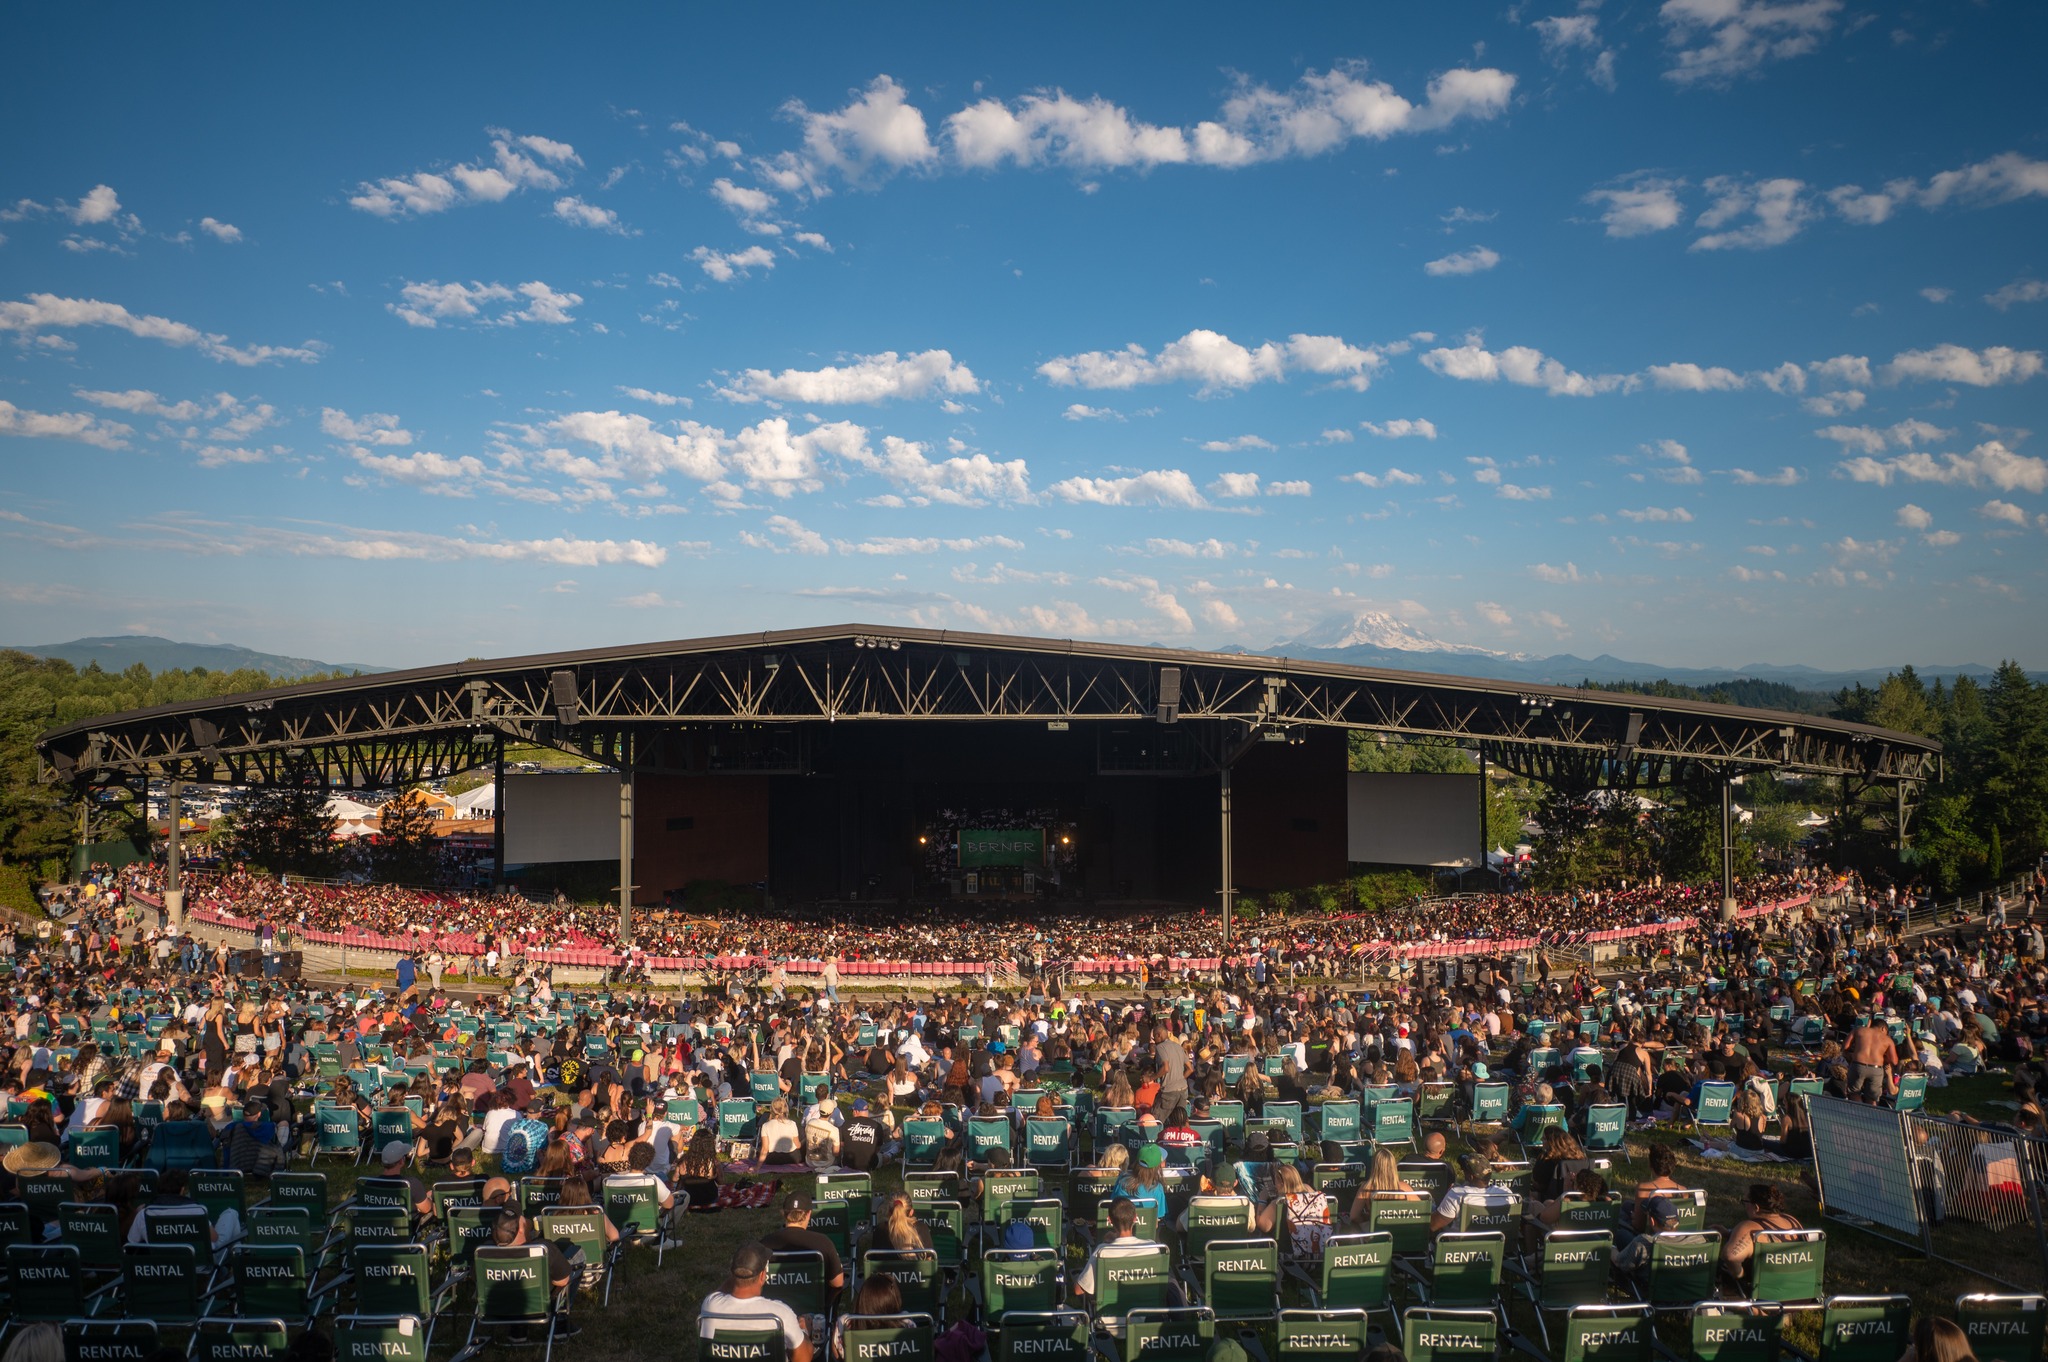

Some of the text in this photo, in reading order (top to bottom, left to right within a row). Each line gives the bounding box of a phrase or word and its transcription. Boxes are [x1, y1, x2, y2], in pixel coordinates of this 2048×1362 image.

[967, 842, 1036, 853] BERNER
[437, 1066, 450, 1074] RENT
[352, 1083, 364, 1091] TAL
[754, 1083, 774, 1091] RENTAL
[1480, 1099, 1502, 1108] RENTAL
[1705, 1098, 1728, 1107] RENTAL
[1075, 1105, 1087, 1113] TAL
[138, 1116, 158, 1126] ENTAL
[668, 1112, 692, 1121] RENTAL
[724, 1114, 749, 1123] RENTAL
[1328, 1117, 1354, 1126] RENTAL
[1382, 1115, 1406, 1125] RENTAL
[1532, 1116, 1558, 1124] RENTAL
[323, 1123, 350, 1134] RENTAL
[379, 1124, 405, 1134] RENTAL
[1595, 1121, 1619, 1132] RENTAL
[910, 1135, 938, 1144] RENTAL
[975, 1135, 1002, 1145] RENTAL
[1033, 1135, 1061, 1146] RENTAL
[1128, 1139, 1155, 1148] RENT
[1203, 1140, 1216, 1149] TAL
[77, 1146, 110, 1156] RENTAL
[197, 1183, 235, 1192] RENTAL
[1322, 1179, 1357, 1189] RENTAL
[1488, 1178, 1523, 1187] RENTAL
[27, 1184, 65, 1194] RENTAL
[279, 1187, 317, 1196] RENTAL
[824, 1188, 861, 1200] RENTAL
[913, 1188, 950, 1198] RENTAL
[992, 1184, 1028, 1194] RENTAL
[1165, 1184, 1191, 1193] NTAL
[364, 1194, 400, 1206] RENTAL
[443, 1197, 482, 1207] RENTAL
[530, 1191, 561, 1202] RENTA
[612, 1193, 649, 1204] RENTAL
[1380, 1210, 1421, 1219] RENTAL
[1570, 1210, 1611, 1221] RENTAL
[1679, 1208, 1697, 1218] TAL
[807, 1216, 839, 1227] ENTAL
[924, 1218, 952, 1228] NTAL
[1199, 1215, 1239, 1225] RENTAL
[1472, 1214, 1512, 1225] RENTAL
[0, 1221, 19, 1231] TAL
[69, 1221, 108, 1233] RENTAL
[155, 1224, 199, 1235] RENTAL
[256, 1226, 300, 1235] RENTAL
[354, 1226, 397, 1237] RENTAL
[552, 1223, 595, 1235] RENTAL
[458, 1227, 491, 1238] RENTA
[1334, 1253, 1380, 1267] RENTAL
[1445, 1251, 1491, 1264] RENTAL
[1555, 1251, 1600, 1264] RENTAL
[1664, 1253, 1709, 1267] RENTAL
[1766, 1252, 1813, 1264] RENTAL
[134, 1265, 184, 1277] RENTAL
[365, 1265, 415, 1277] RENTAL
[1218, 1259, 1267, 1272] RENTAL
[19, 1268, 70, 1279] RENTAL
[246, 1266, 294, 1278] RENTAL
[486, 1267, 536, 1281] RENTAL
[890, 1271, 926, 1283] NTAL
[1108, 1267, 1157, 1281] RENTAL
[995, 1273, 1044, 1286] RENTAL
[1836, 1322, 1894, 1335] RENTAL
[1968, 1322, 2029, 1335] RENTAL
[1290, 1334, 1350, 1348] RENTAL
[1420, 1334, 1482, 1348] RENTAL
[1581, 1331, 1639, 1346] RENTAL
[1706, 1329, 1766, 1342] RENTAL
[1013, 1339, 1073, 1353] RENTAL
[1141, 1335, 1200, 1349] RENTAL
[79, 1345, 144, 1359] RENTAL
[212, 1345, 273, 1359] RENTAL
[352, 1343, 411, 1356] RENTAL
[711, 1343, 771, 1359] RENTAL
[858, 1340, 920, 1358] RENTAL
